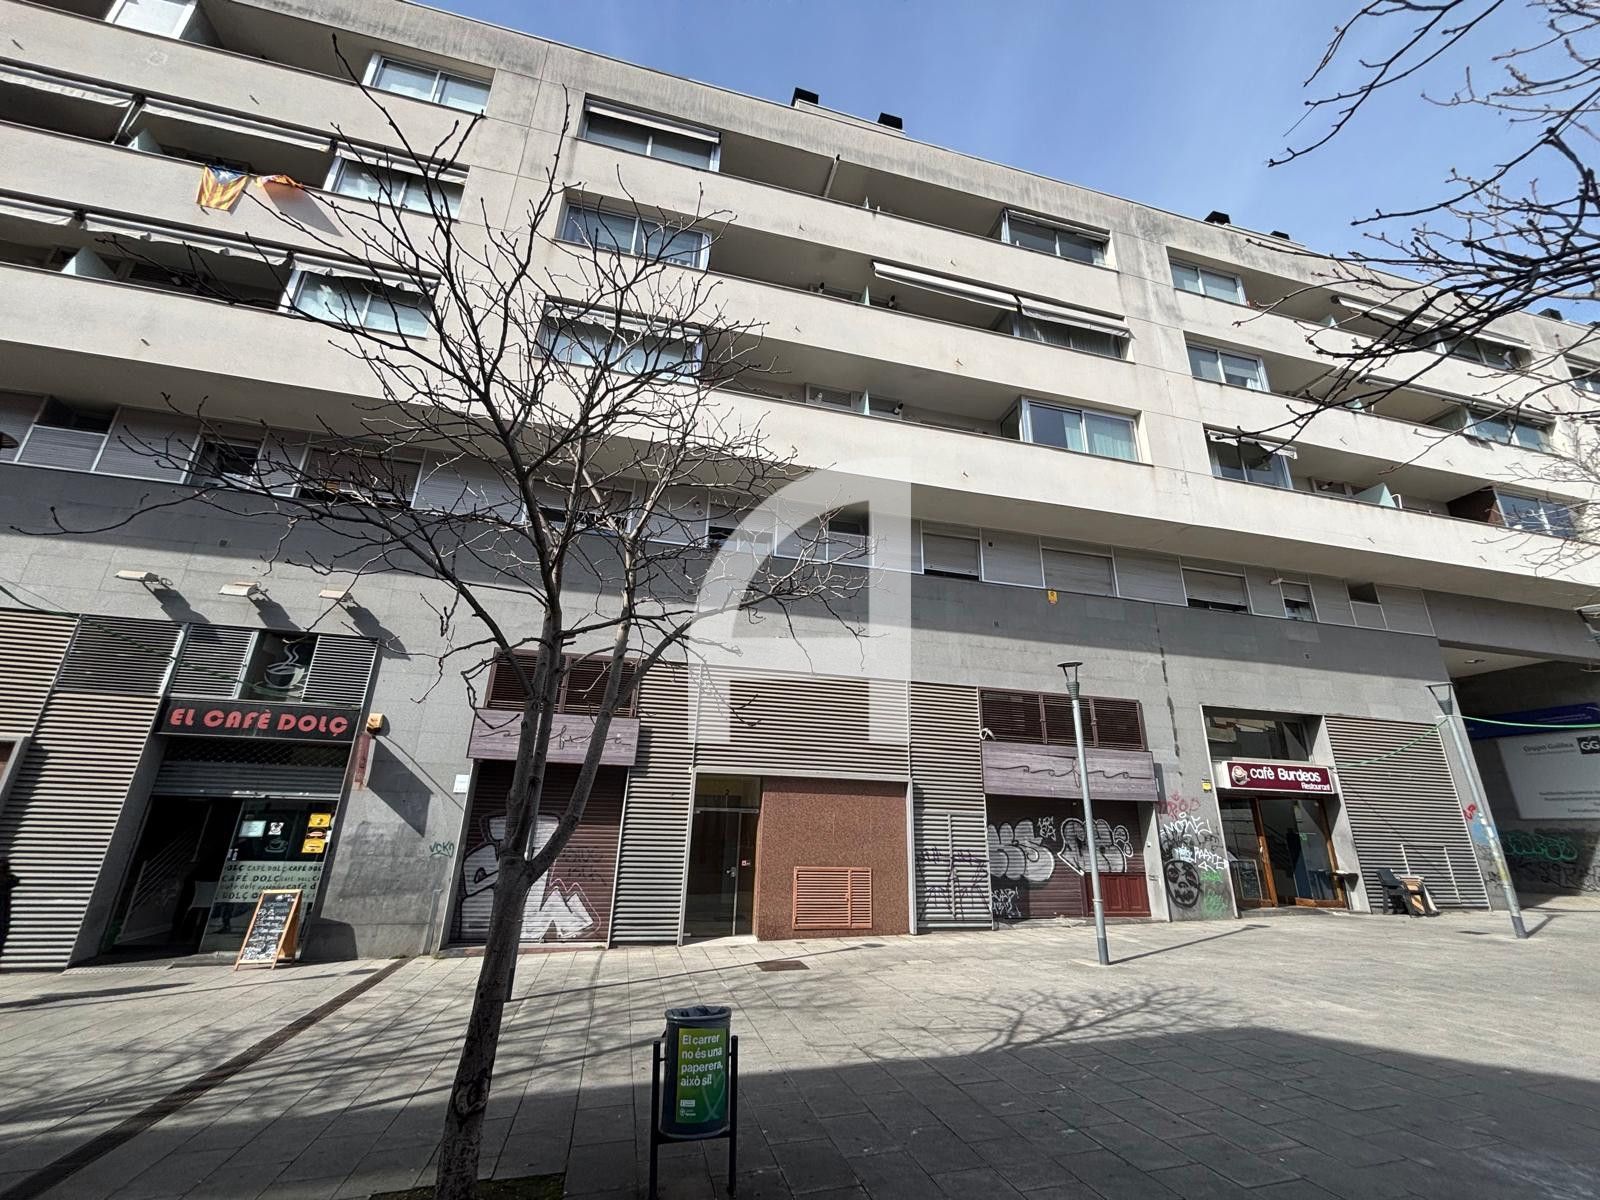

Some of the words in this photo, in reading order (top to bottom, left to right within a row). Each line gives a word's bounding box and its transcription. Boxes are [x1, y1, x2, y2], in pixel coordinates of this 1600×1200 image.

[170, 708, 196, 727] EL
[203, 709, 272, 730] CAFÈ
[277, 713, 348, 737] DOLÇ
[1249, 766, 1275, 780] cafè
[1277, 767, 1321, 782] Burdeos
[1301, 782, 1331, 791] Restaurant
[682, 1034, 692, 1045] El
[692, 1034, 721, 1045] carrer
[681, 1050, 694, 1060] no
[695, 1047, 707, 1059] és
[707, 1047, 723, 1058] una
[680, 1075, 701, 1087] això
